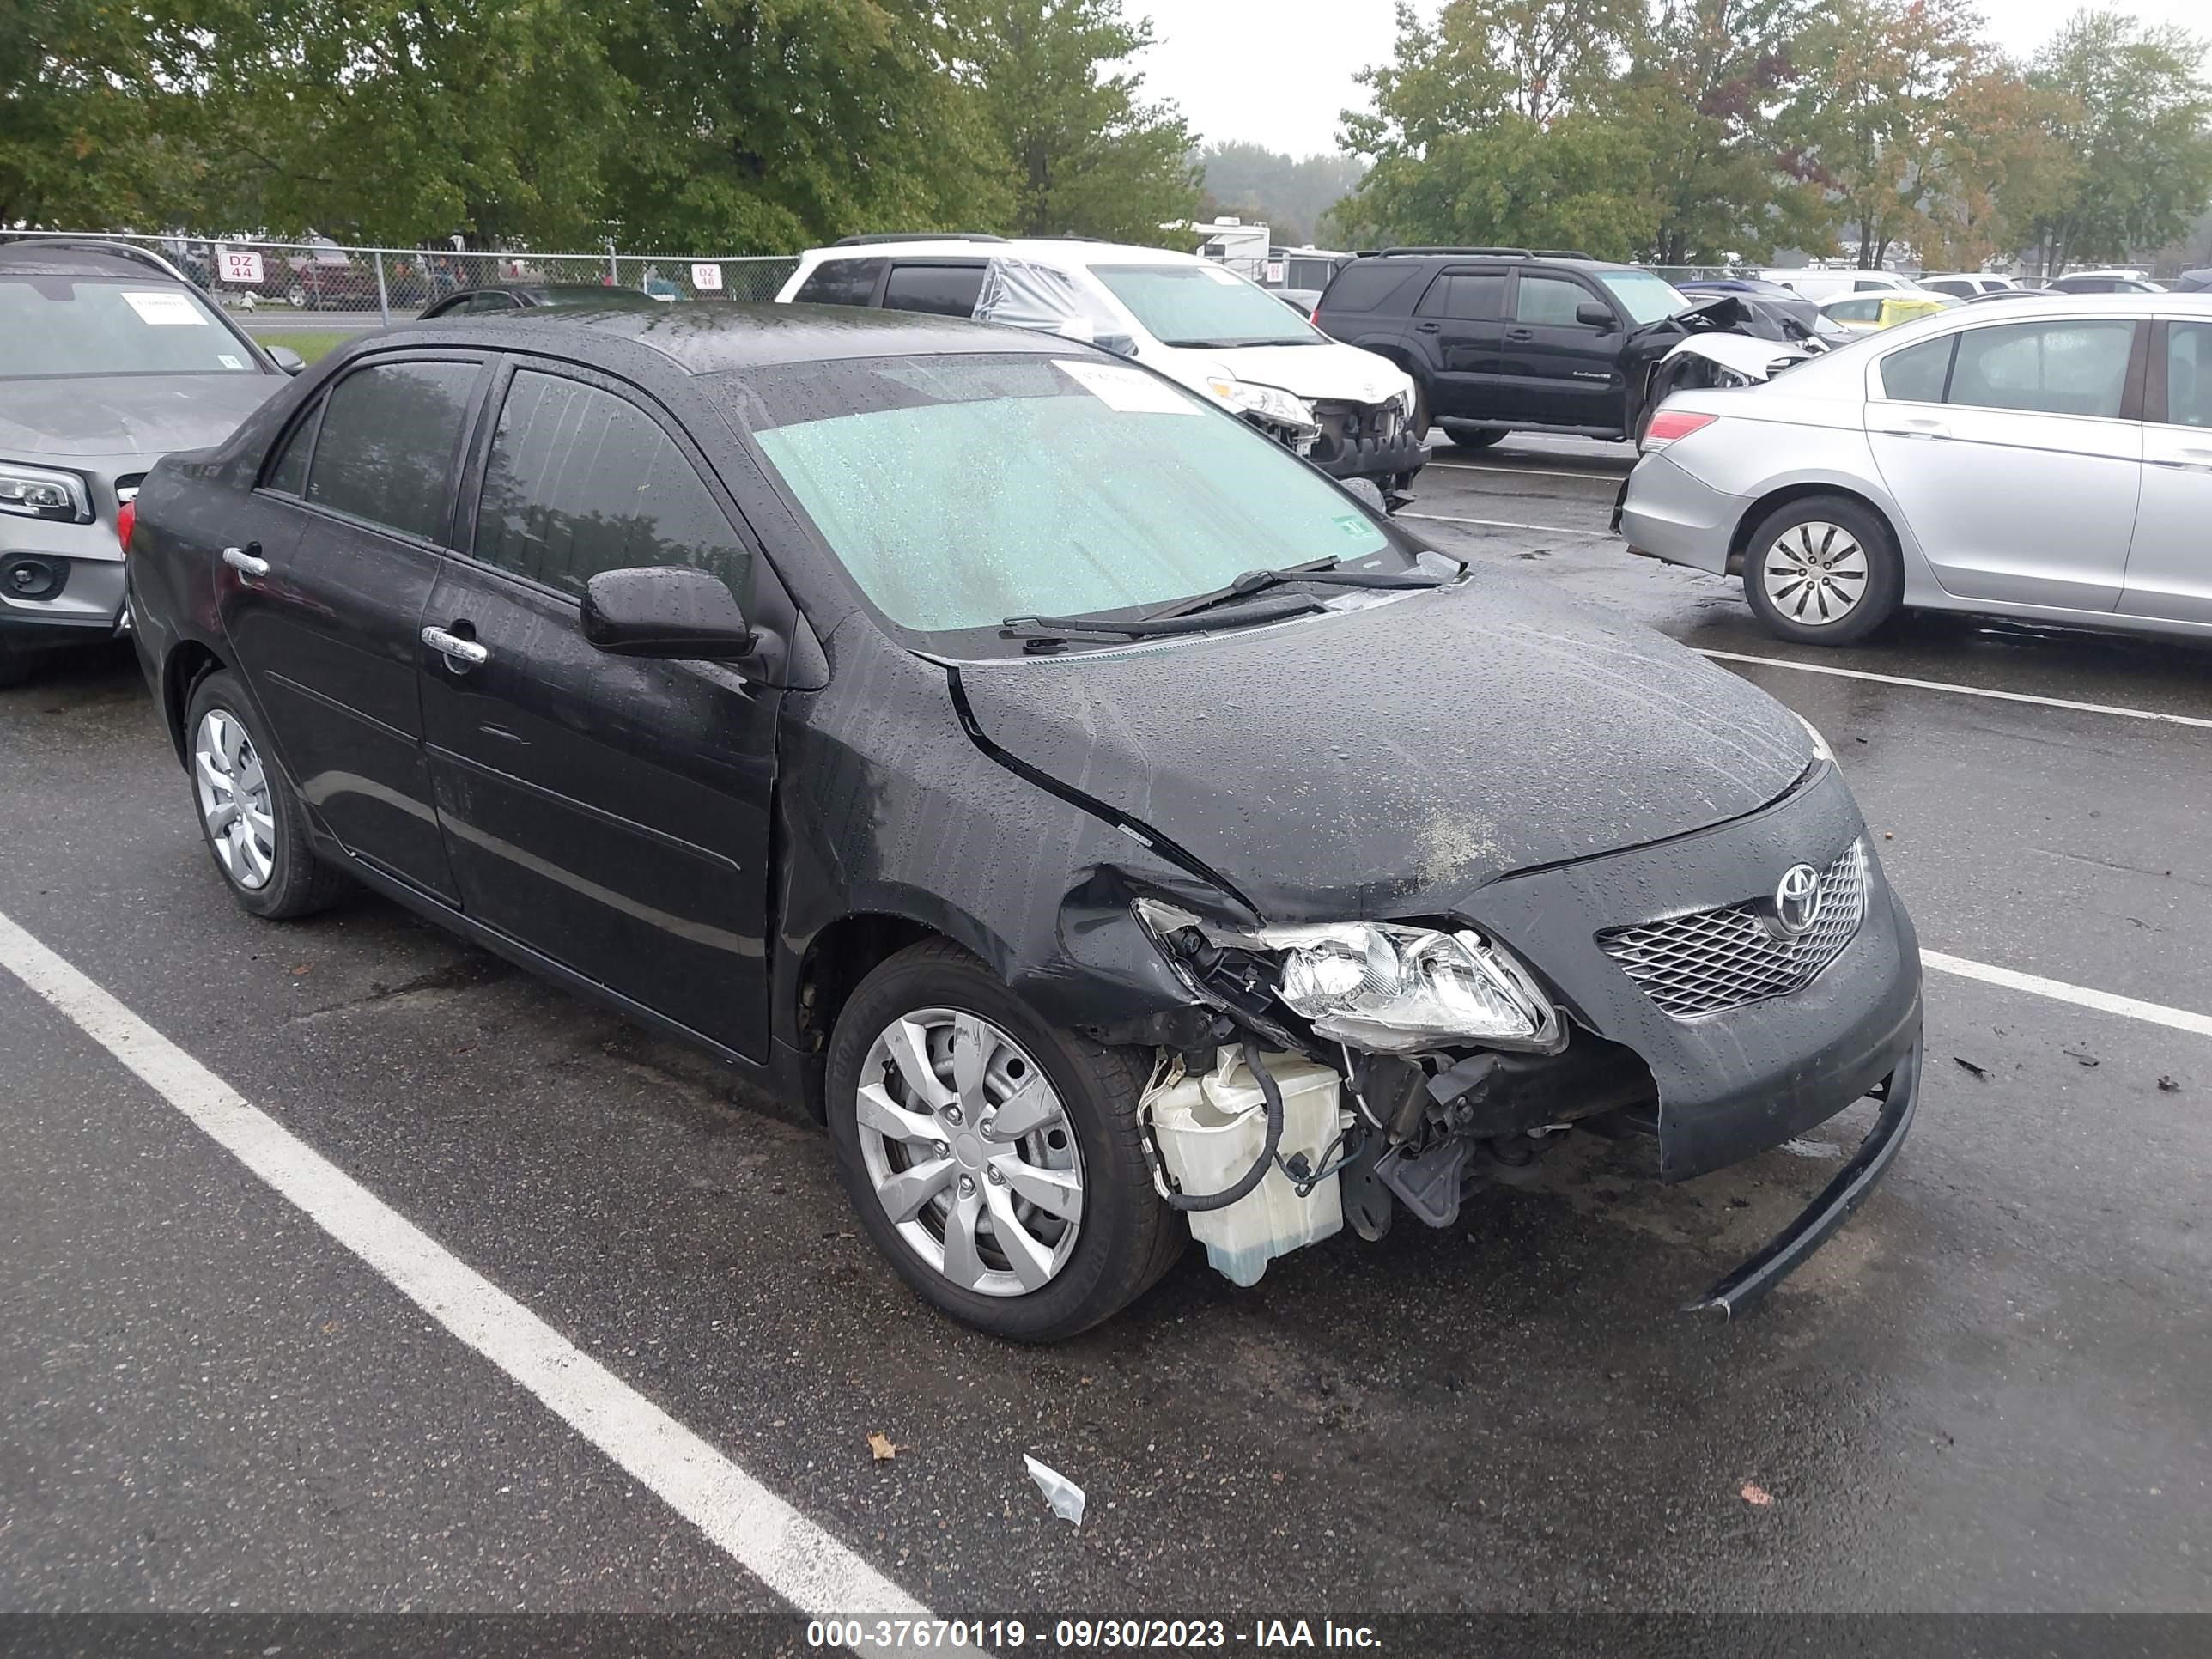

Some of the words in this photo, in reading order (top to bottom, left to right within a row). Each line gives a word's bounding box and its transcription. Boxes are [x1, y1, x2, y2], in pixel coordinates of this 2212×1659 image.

[229, 255, 253, 266] DZ
[232, 267, 252, 277] 44
[699, 267, 714, 276] DZ
